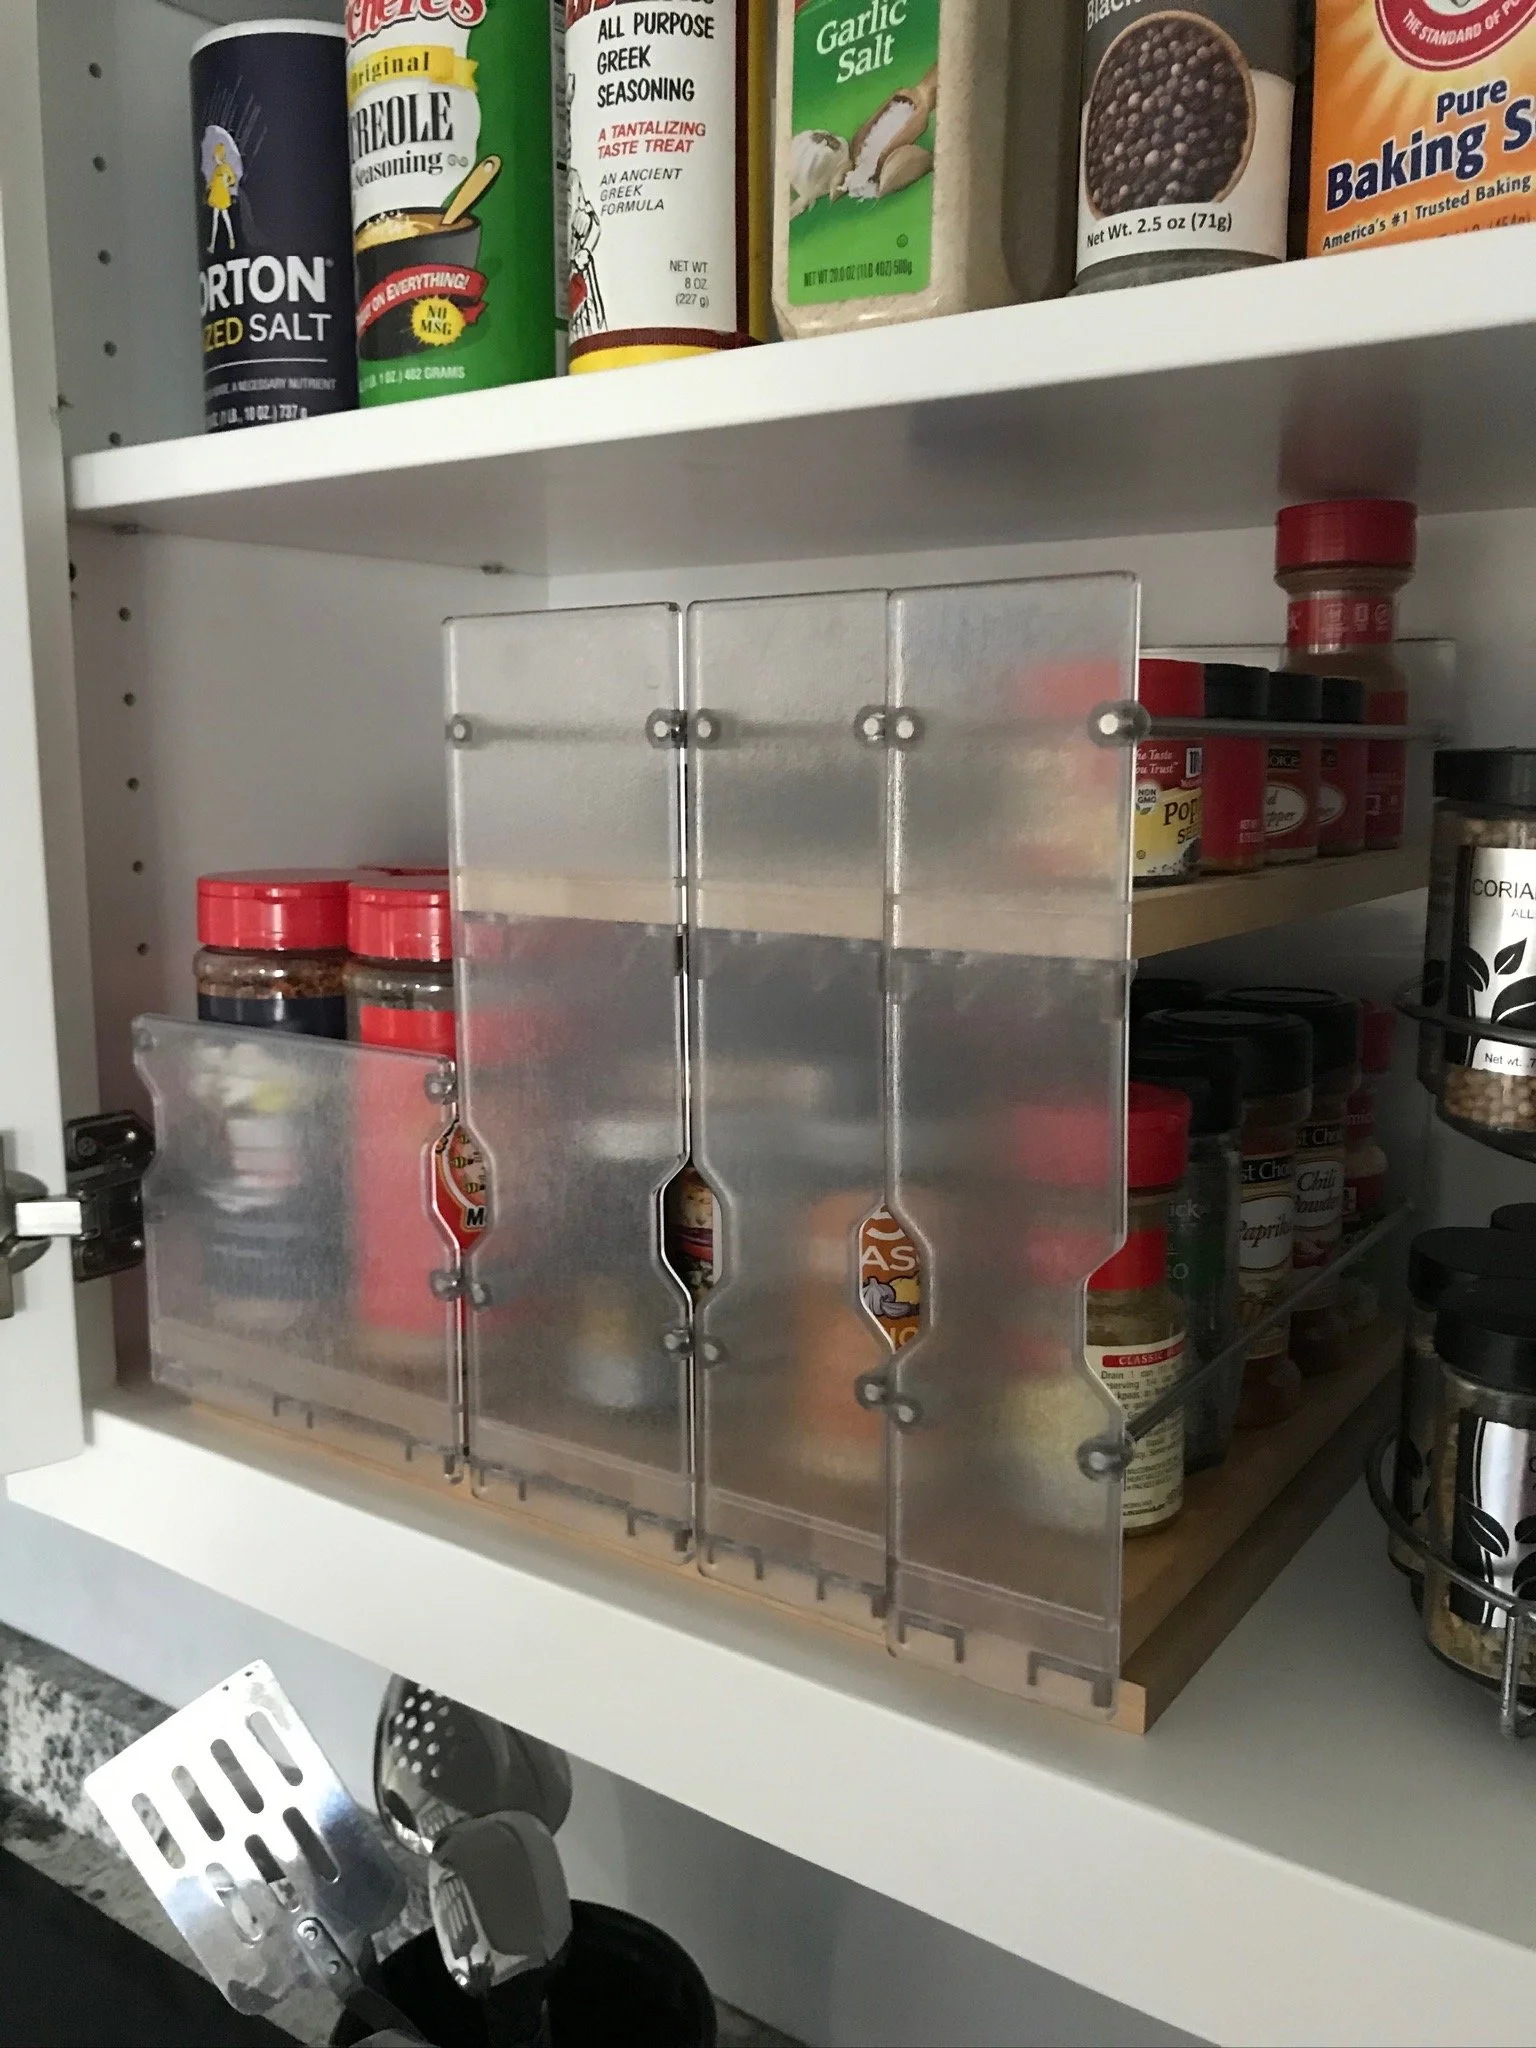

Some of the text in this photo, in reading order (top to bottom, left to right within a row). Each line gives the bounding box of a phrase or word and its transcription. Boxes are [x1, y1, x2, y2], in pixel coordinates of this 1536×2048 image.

[597, 15, 625, 44] ALL
[633, 11, 715, 39] PURPOSE
[816, 0, 907, 55] Garlic
[1402, 8, 1422, 35] THE
[1418, 22, 1482, 46] STANDARD
[1484, 9, 1500, 30] OF
[597, 44, 651, 75] GREEK
[836, 33, 895, 83] Salt
[597, 77, 695, 108] SEASONING
[1436, 79, 1508, 123] Pure
[598, 120, 706, 142] A TANTALIZING
[598, 138, 695, 160] TASTE TREAT
[1326, 98, 1536, 212] Baking S
[600, 168, 683, 186] AN ANCIENT
[600, 184, 643, 201] GREEK
[600, 198, 665, 216] FORMULA
[1323, 175, 1532, 251] America's #1 Trusted Baking
[1086, 212, 1232, 247] Net Wt. 2.5 oz (71g)
[669, 260, 708, 273] NET WT
[386, 271, 471, 302] EVERYTHING!
[684, 277, 707, 290] 8 OZ
[427, 304, 447, 319] NO
[249, 312, 332, 342] SALT
[420, 319, 452, 335] MSG
[424, 365, 466, 380] GRAMS
[1136, 749, 1173, 761] he Taste
[1135, 764, 1149, 775] ou
[1137, 796, 1157, 804] GMO
[1138, 788, 1157, 796] NON
[1472, 878, 1536, 900] CORIA
[1484, 1052, 1503, 1065] Net
[1297, 1169, 1337, 1192] Chili
[862, 1245, 920, 1271] AS
[1118, 1351, 1164, 1366] CLASSIC
[1101, 1370, 1124, 1380] Drain
